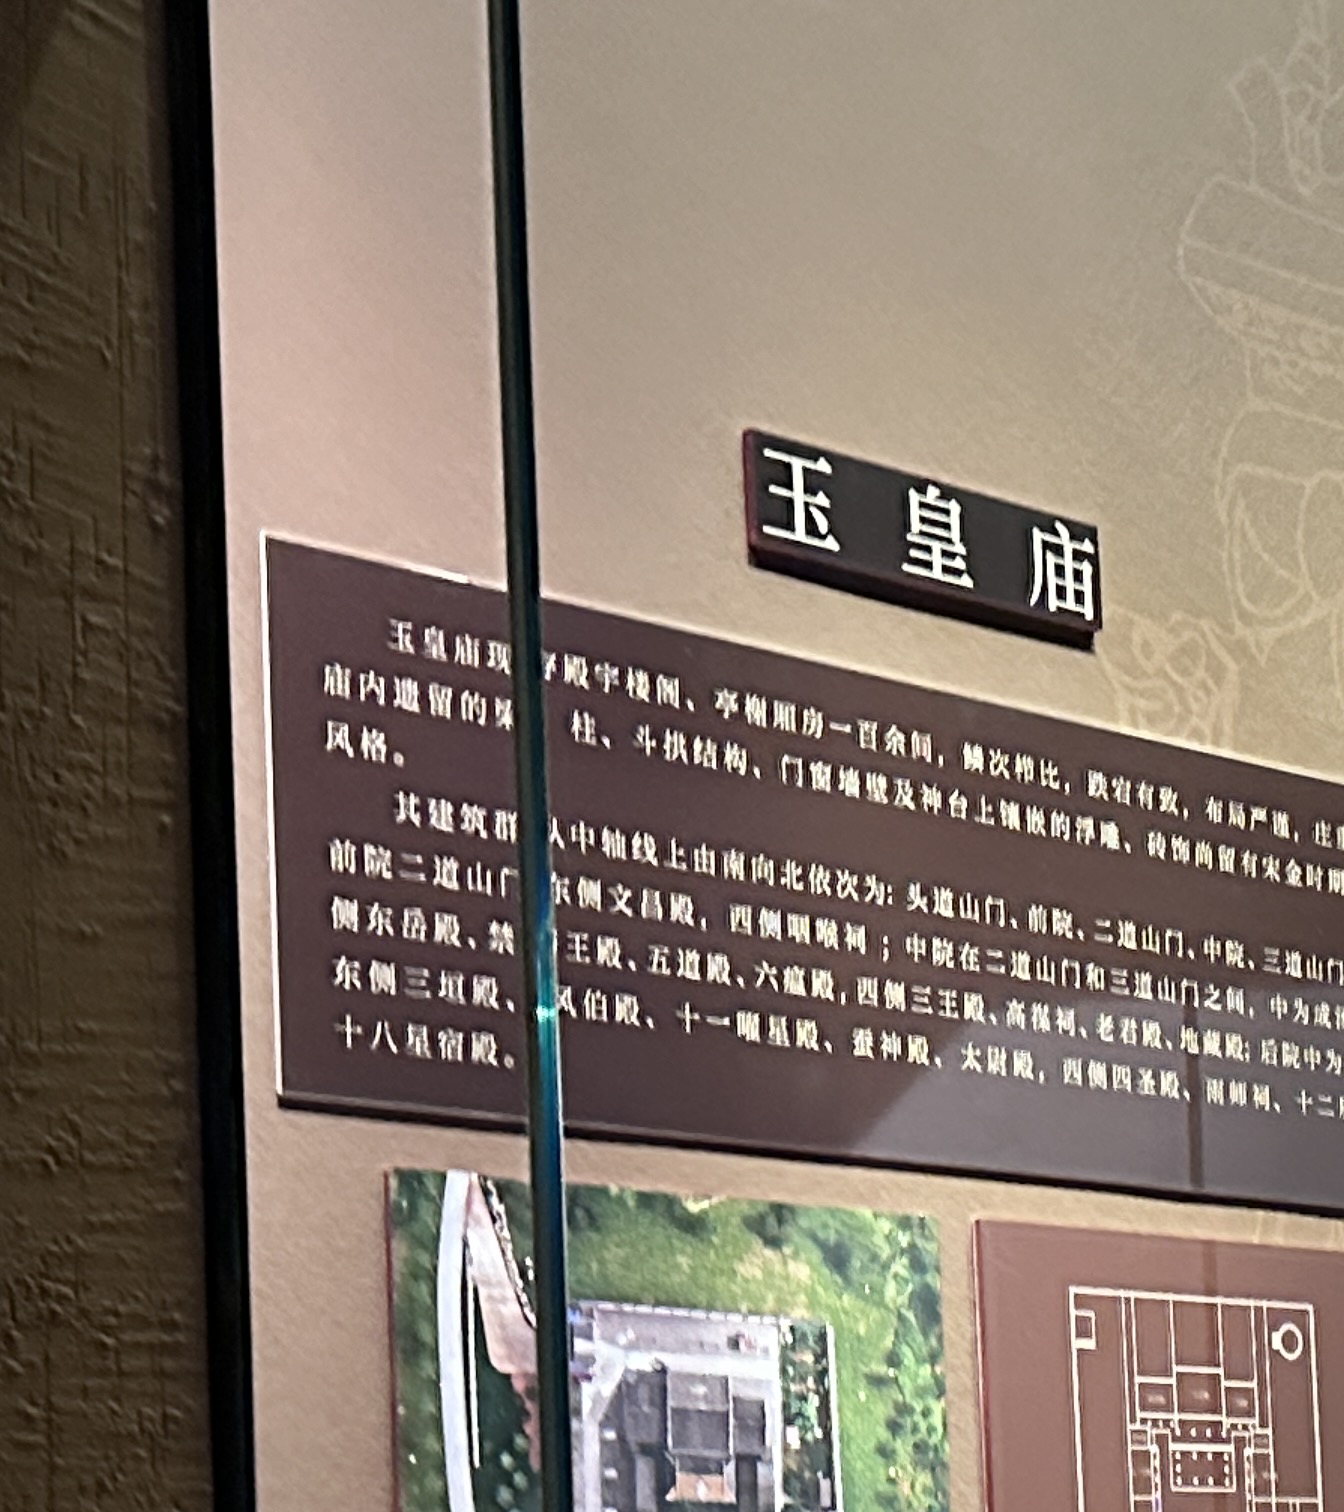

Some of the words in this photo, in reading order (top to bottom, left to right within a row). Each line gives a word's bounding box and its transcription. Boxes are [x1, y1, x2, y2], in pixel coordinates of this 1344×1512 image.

[762, 447, 1095, 621] 玉皇庙
[325, 719, 405, 768] 风格。
[334, 1013, 515, 1070] 十八星宿殿。
